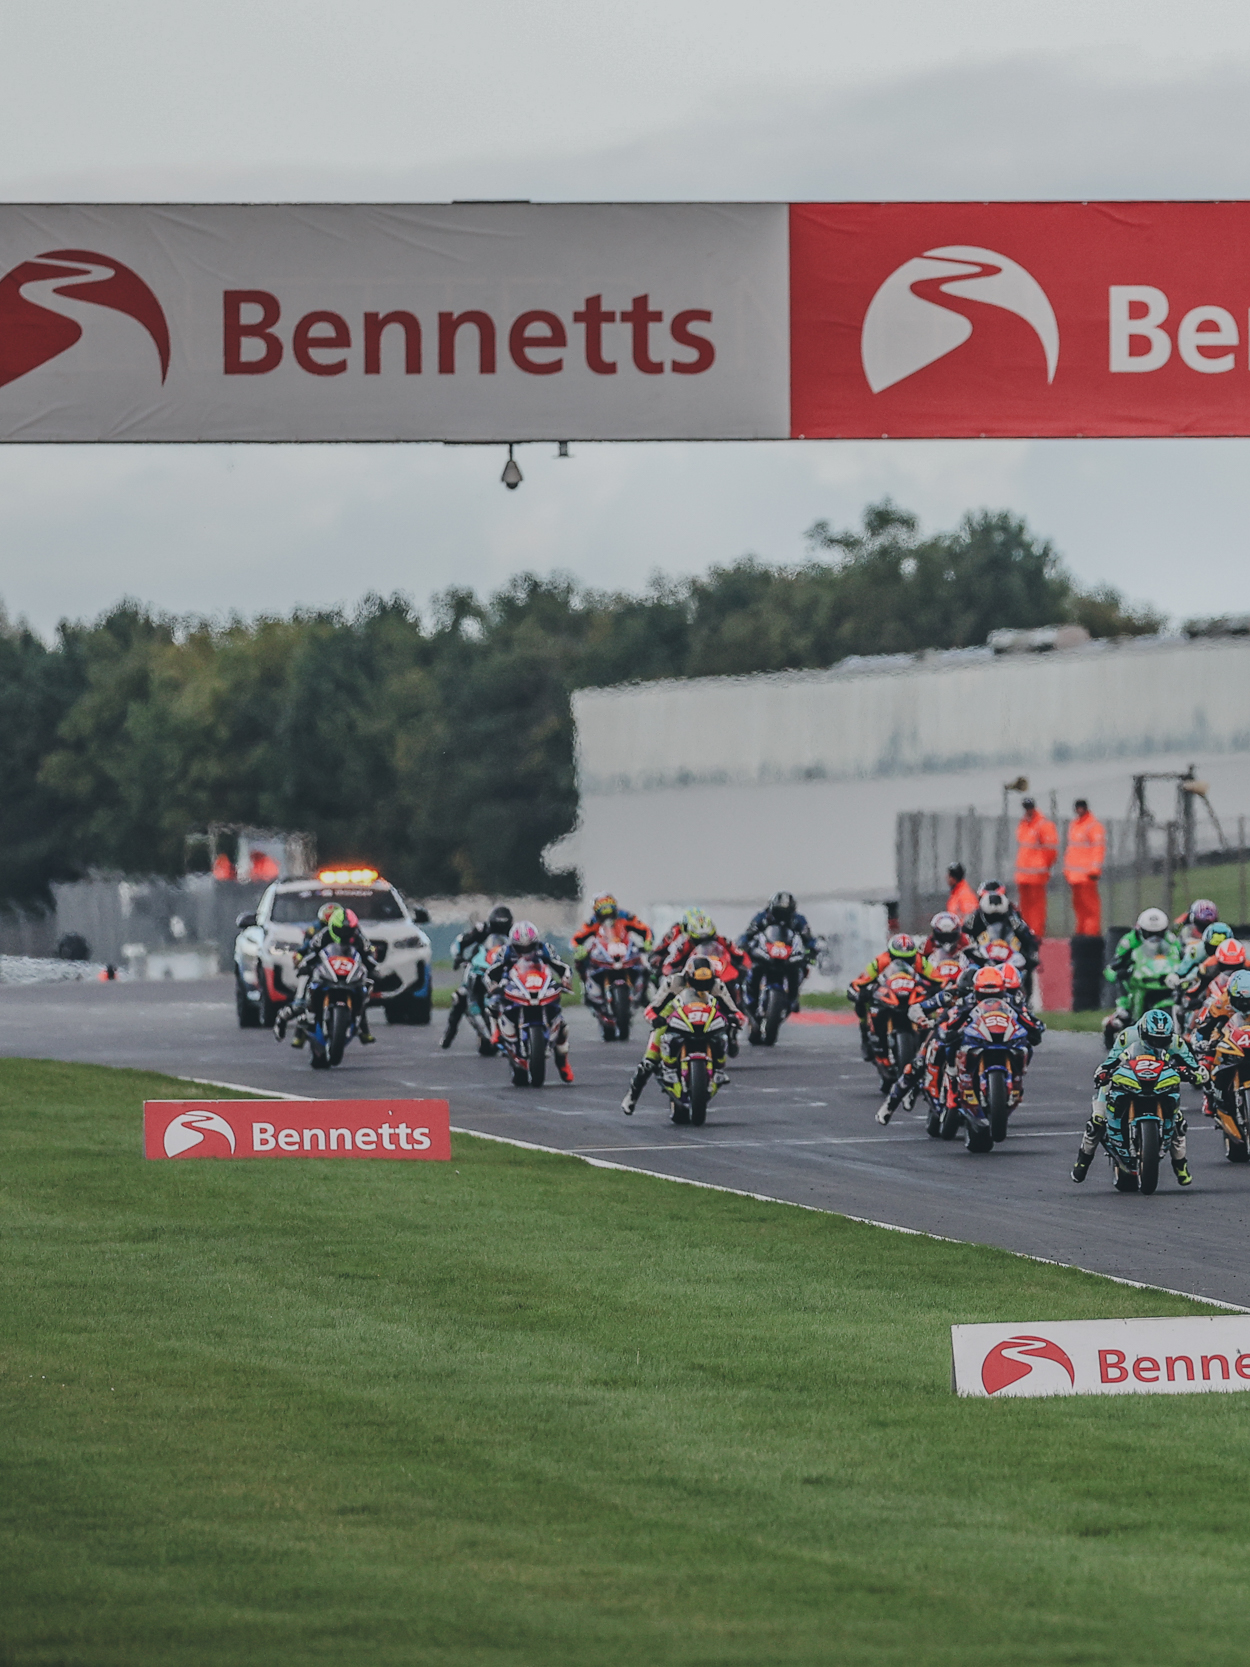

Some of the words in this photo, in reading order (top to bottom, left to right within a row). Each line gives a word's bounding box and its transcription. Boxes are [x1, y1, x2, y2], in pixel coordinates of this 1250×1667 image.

[223, 289, 717, 377] Bennetts
[1135, 1060, 1161, 1071] 27
[252, 1122, 432, 1151] Bennetts
